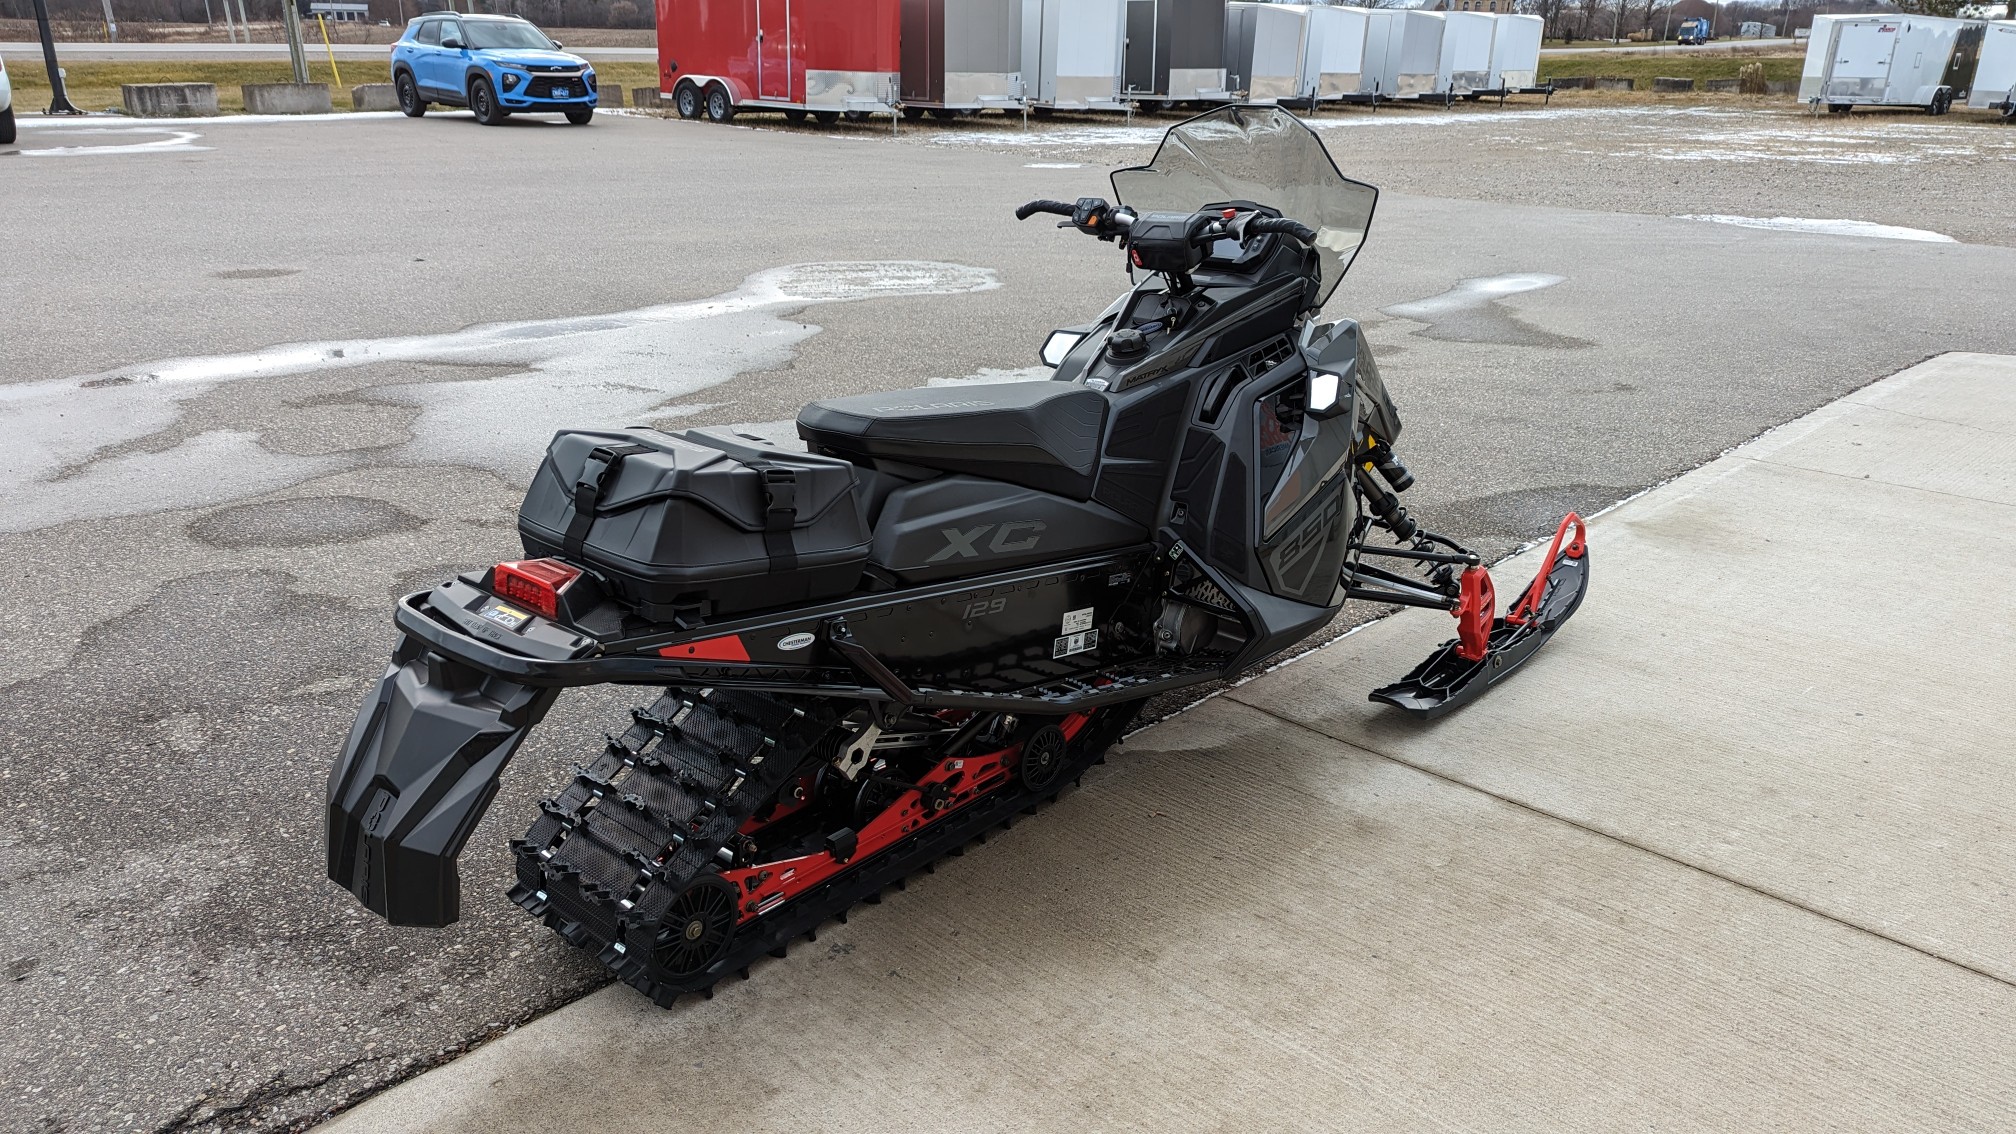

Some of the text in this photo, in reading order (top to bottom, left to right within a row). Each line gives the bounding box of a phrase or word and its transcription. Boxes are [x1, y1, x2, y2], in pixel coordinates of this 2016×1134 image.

[1126, 365, 1169, 386] MATRYX
[872, 400, 995, 413] POLARIS
[924, 519, 1047, 562] XC
[1278, 494, 1341, 571] 850
[962, 598, 1006, 620] 129
[782, 636, 812, 647] CHESTERMAN
